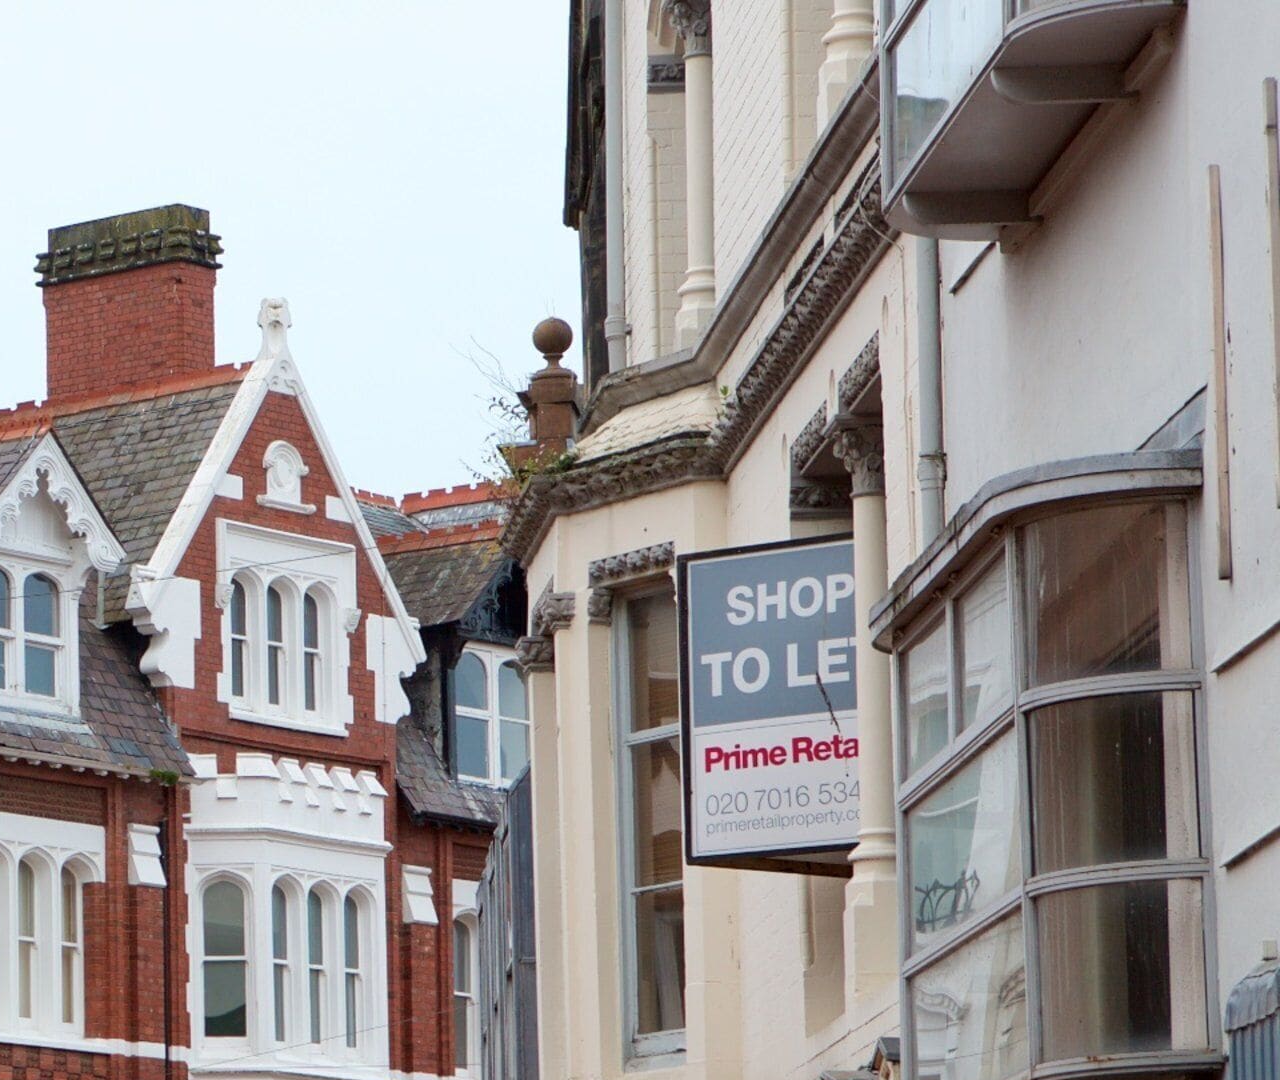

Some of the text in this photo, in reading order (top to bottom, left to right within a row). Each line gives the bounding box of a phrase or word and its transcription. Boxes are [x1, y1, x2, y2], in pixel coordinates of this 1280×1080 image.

[726, 572, 855, 626] SHOP
[701, 647, 770, 698] TO
[704, 734, 859, 773] Prime Reta
[705, 780, 860, 817] 020 7016 534
